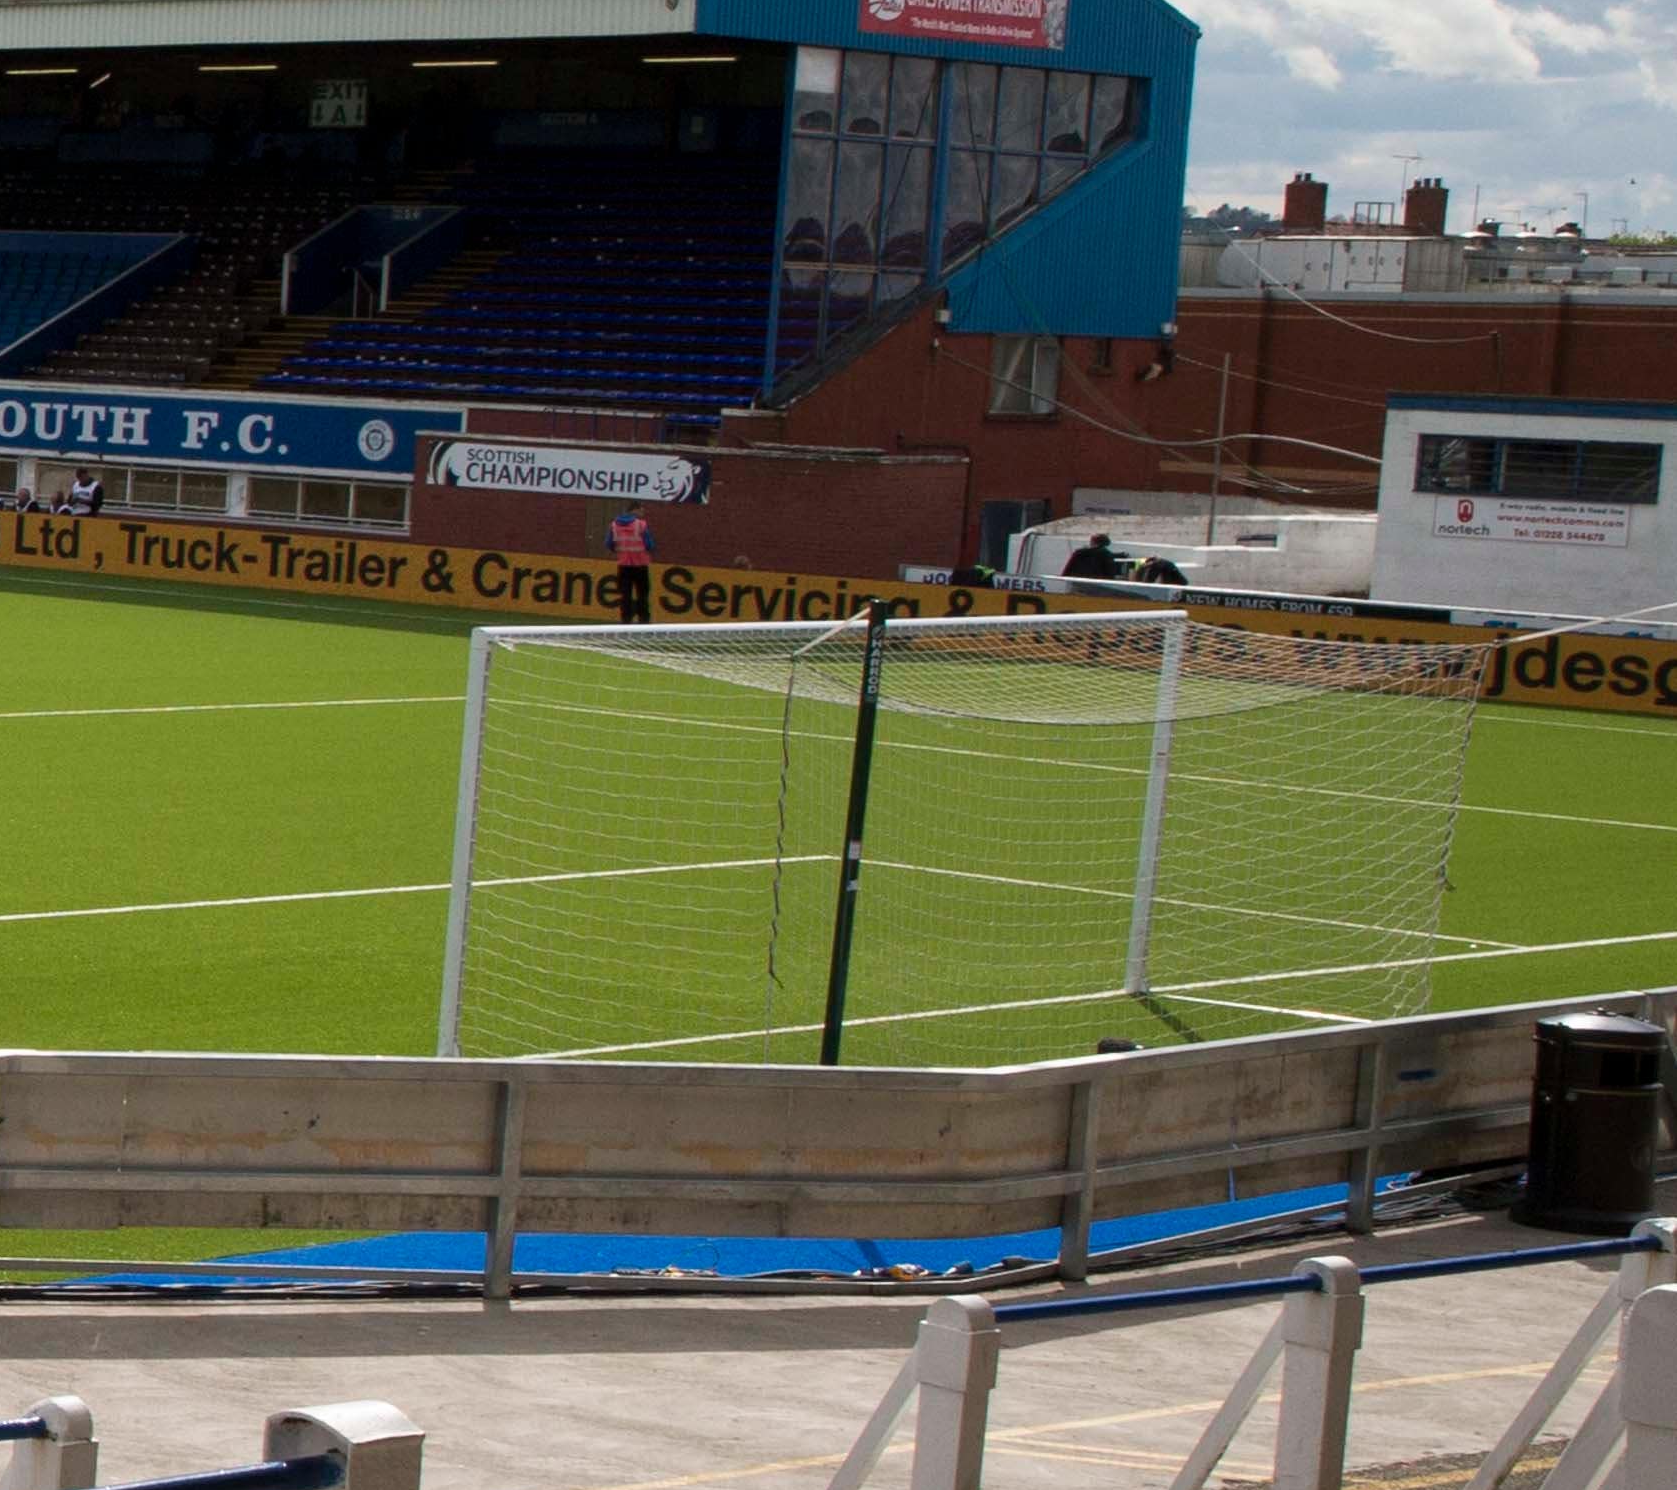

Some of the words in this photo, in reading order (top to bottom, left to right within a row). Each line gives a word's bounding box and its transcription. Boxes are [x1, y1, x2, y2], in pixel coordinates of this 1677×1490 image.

[312, 83, 365, 100] EXIT
[332, 105, 346, 125] A
[180, 410, 288, 455] F.C.
[467, 448, 535, 464] SCOTTISH
[466, 462, 649, 494] CHAMPIONSHIP
[1438, 522, 1490, 536] nortech
[15, 512, 81, 559] Ltd
[120, 522, 408, 588] Truck-Trailer
[422, 549, 456, 594] &
[1224, 595, 1277, 611] HOMES
[866, 638, 882, 694] HARROD
